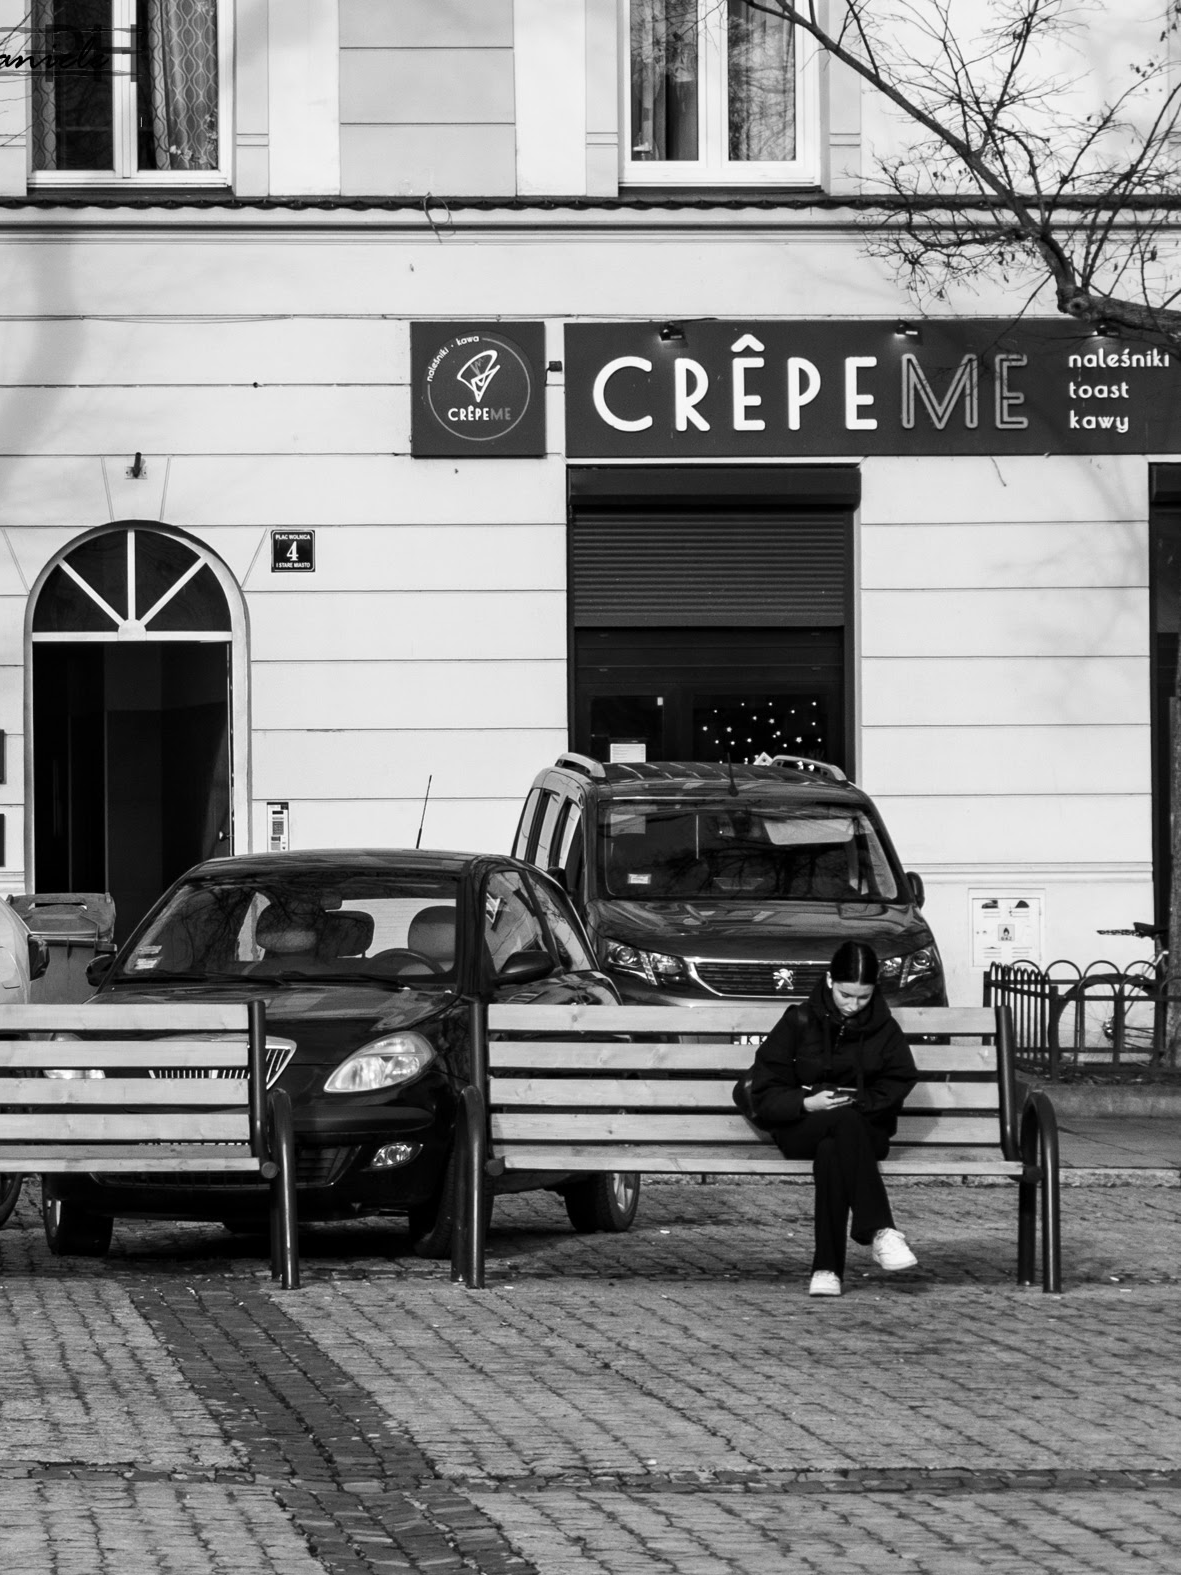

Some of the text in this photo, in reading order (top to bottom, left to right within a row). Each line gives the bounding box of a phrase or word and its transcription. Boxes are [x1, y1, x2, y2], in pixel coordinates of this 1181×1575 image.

[426, 335, 480, 382] naleśniki kawa
[1068, 347, 1170, 368] naleśniki
[1068, 381, 1129, 399] toast
[1069, 409, 1129, 433] kawy
[286, 540, 299, 561] 4
